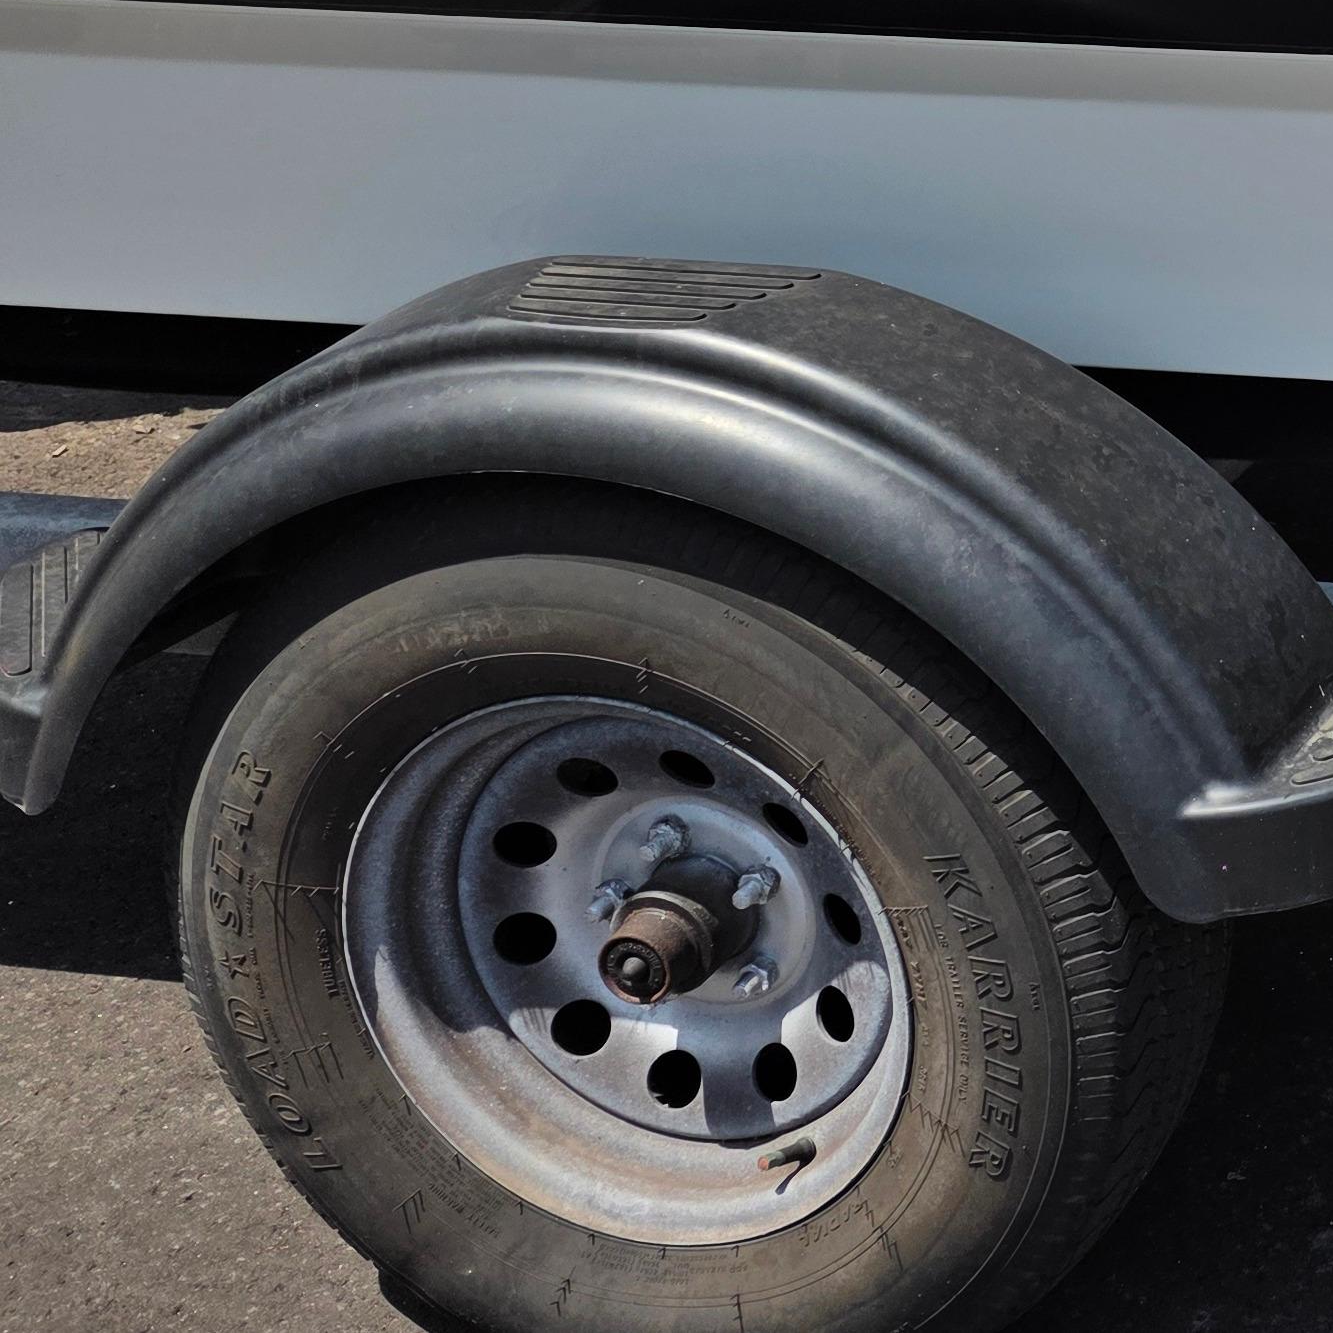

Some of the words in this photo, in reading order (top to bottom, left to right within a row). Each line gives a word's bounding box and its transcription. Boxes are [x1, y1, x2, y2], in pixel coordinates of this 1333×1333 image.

[208, 748, 273, 937] STAR
[313, 927, 341, 1001] TUBELESS
[922, 852, 1023, 1184] KARRIER
[945, 955, 966, 1010] TRAILER
[957, 1015, 971, 1068] SERVICE
[226, 993, 344, 1173] LOAD
